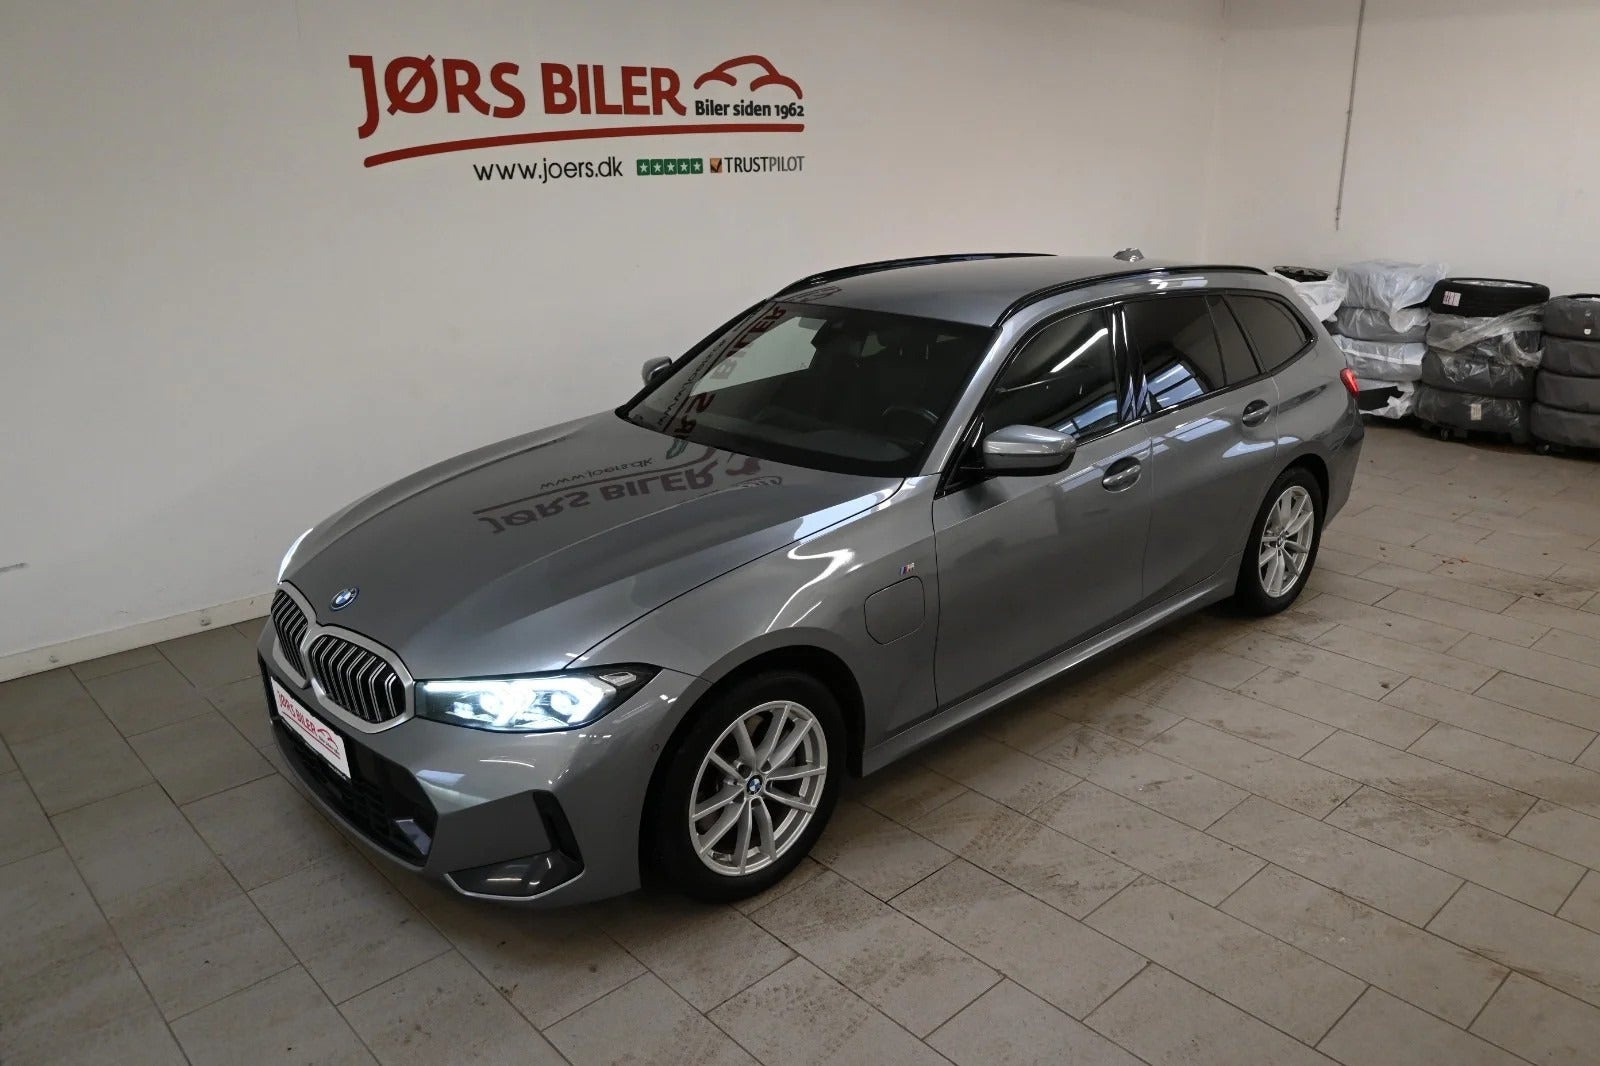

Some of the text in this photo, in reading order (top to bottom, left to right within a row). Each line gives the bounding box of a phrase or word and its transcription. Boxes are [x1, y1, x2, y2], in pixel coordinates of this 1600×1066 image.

[348, 54, 688, 140] JØRS BILER
[694, 98, 805, 120] Biler siden 1962
[472, 155, 624, 185] www.joers.dk
[723, 155, 806, 174] TRUSTPILOT
